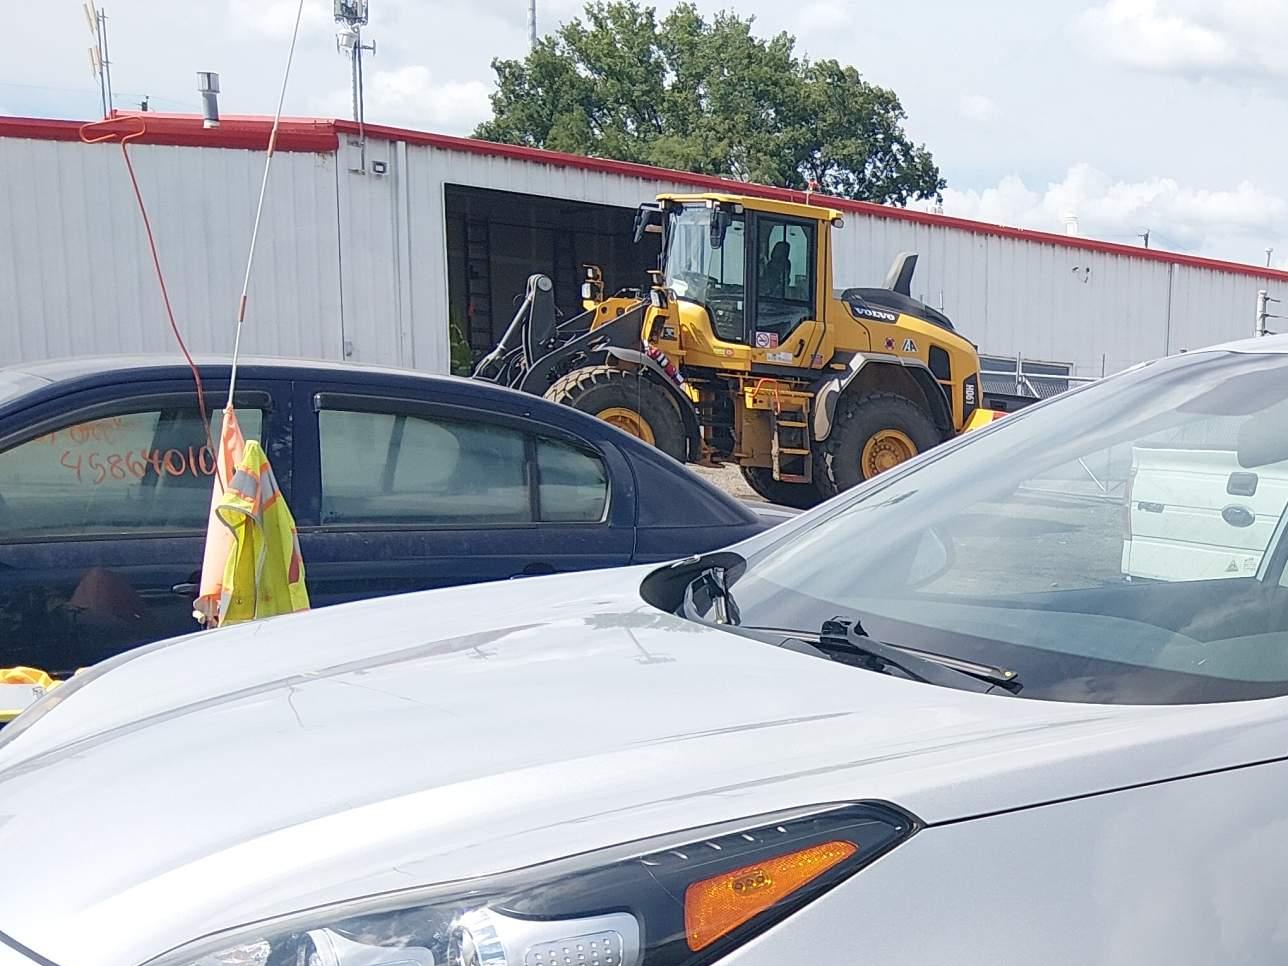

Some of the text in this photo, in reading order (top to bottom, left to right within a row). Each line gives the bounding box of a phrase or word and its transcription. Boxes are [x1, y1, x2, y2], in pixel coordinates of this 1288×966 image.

[855, 307, 895, 321] VOLVO
[965, 384, 975, 405] L90H
[60, 446, 216, 484] 45864010
